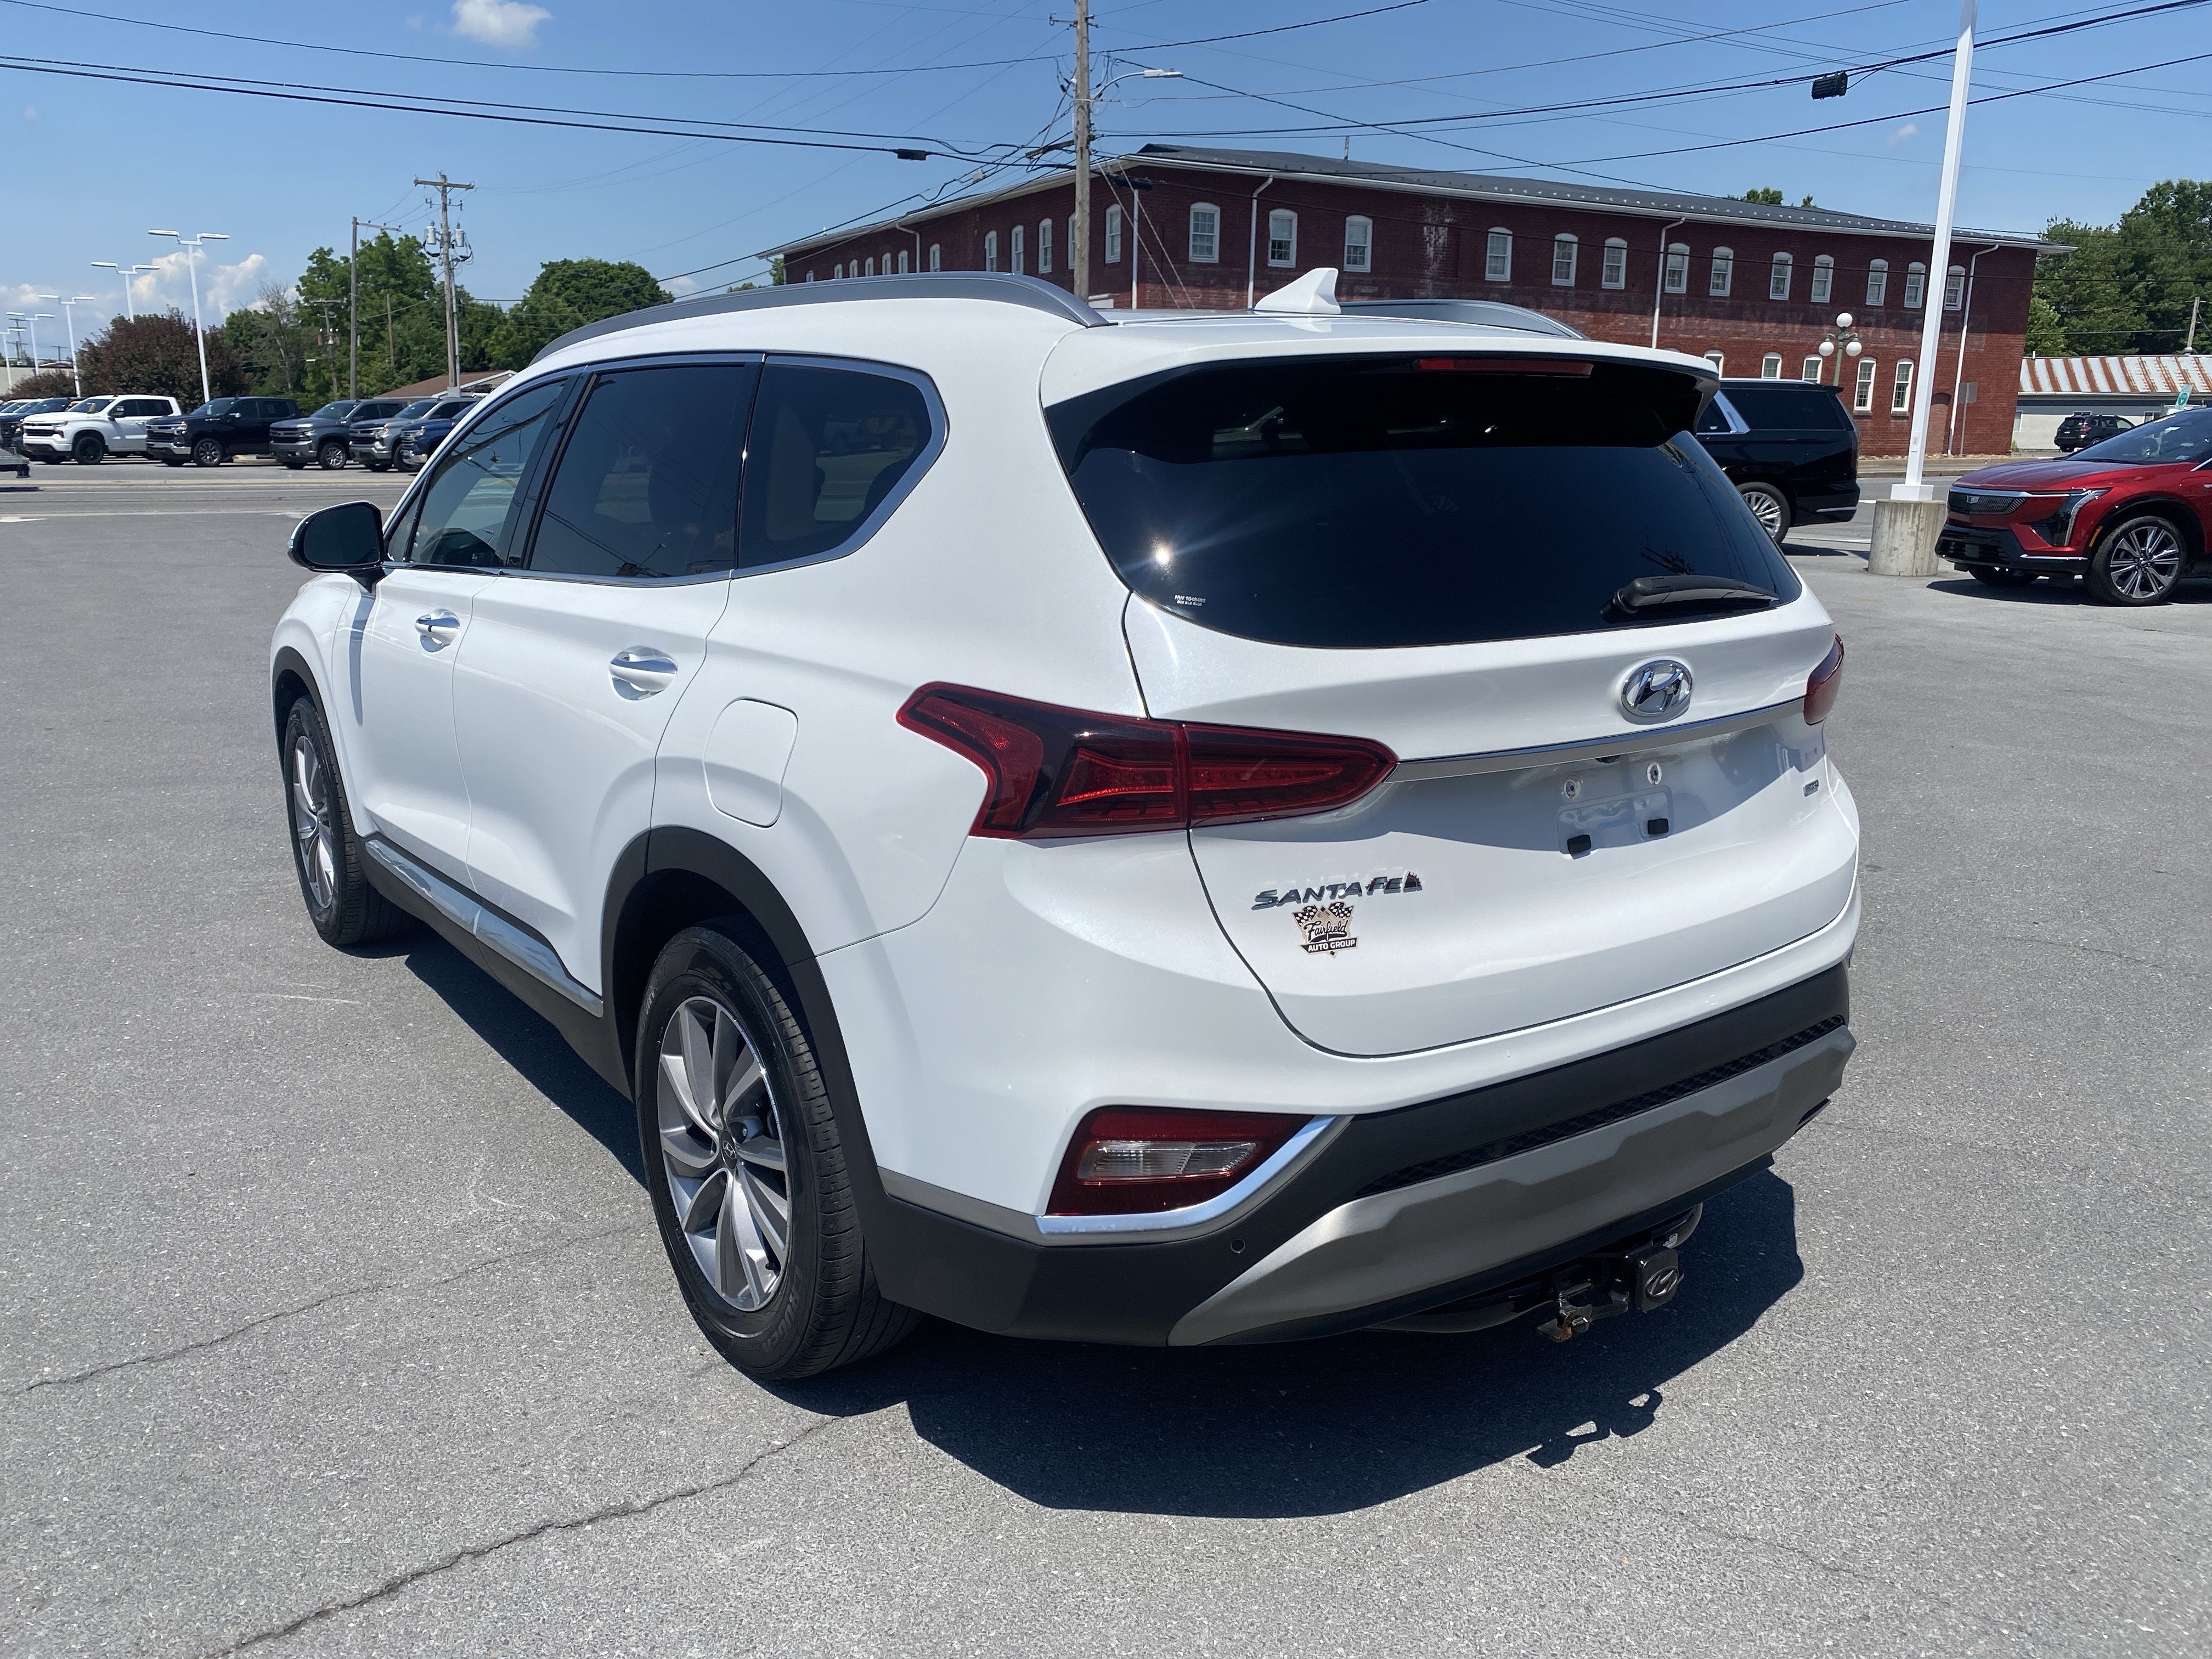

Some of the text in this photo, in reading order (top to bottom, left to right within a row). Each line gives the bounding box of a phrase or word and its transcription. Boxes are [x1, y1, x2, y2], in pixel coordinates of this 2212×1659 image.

[1303, 919, 1348, 943] Fairfield
[1308, 939, 1356, 952] AUTO GROUP
